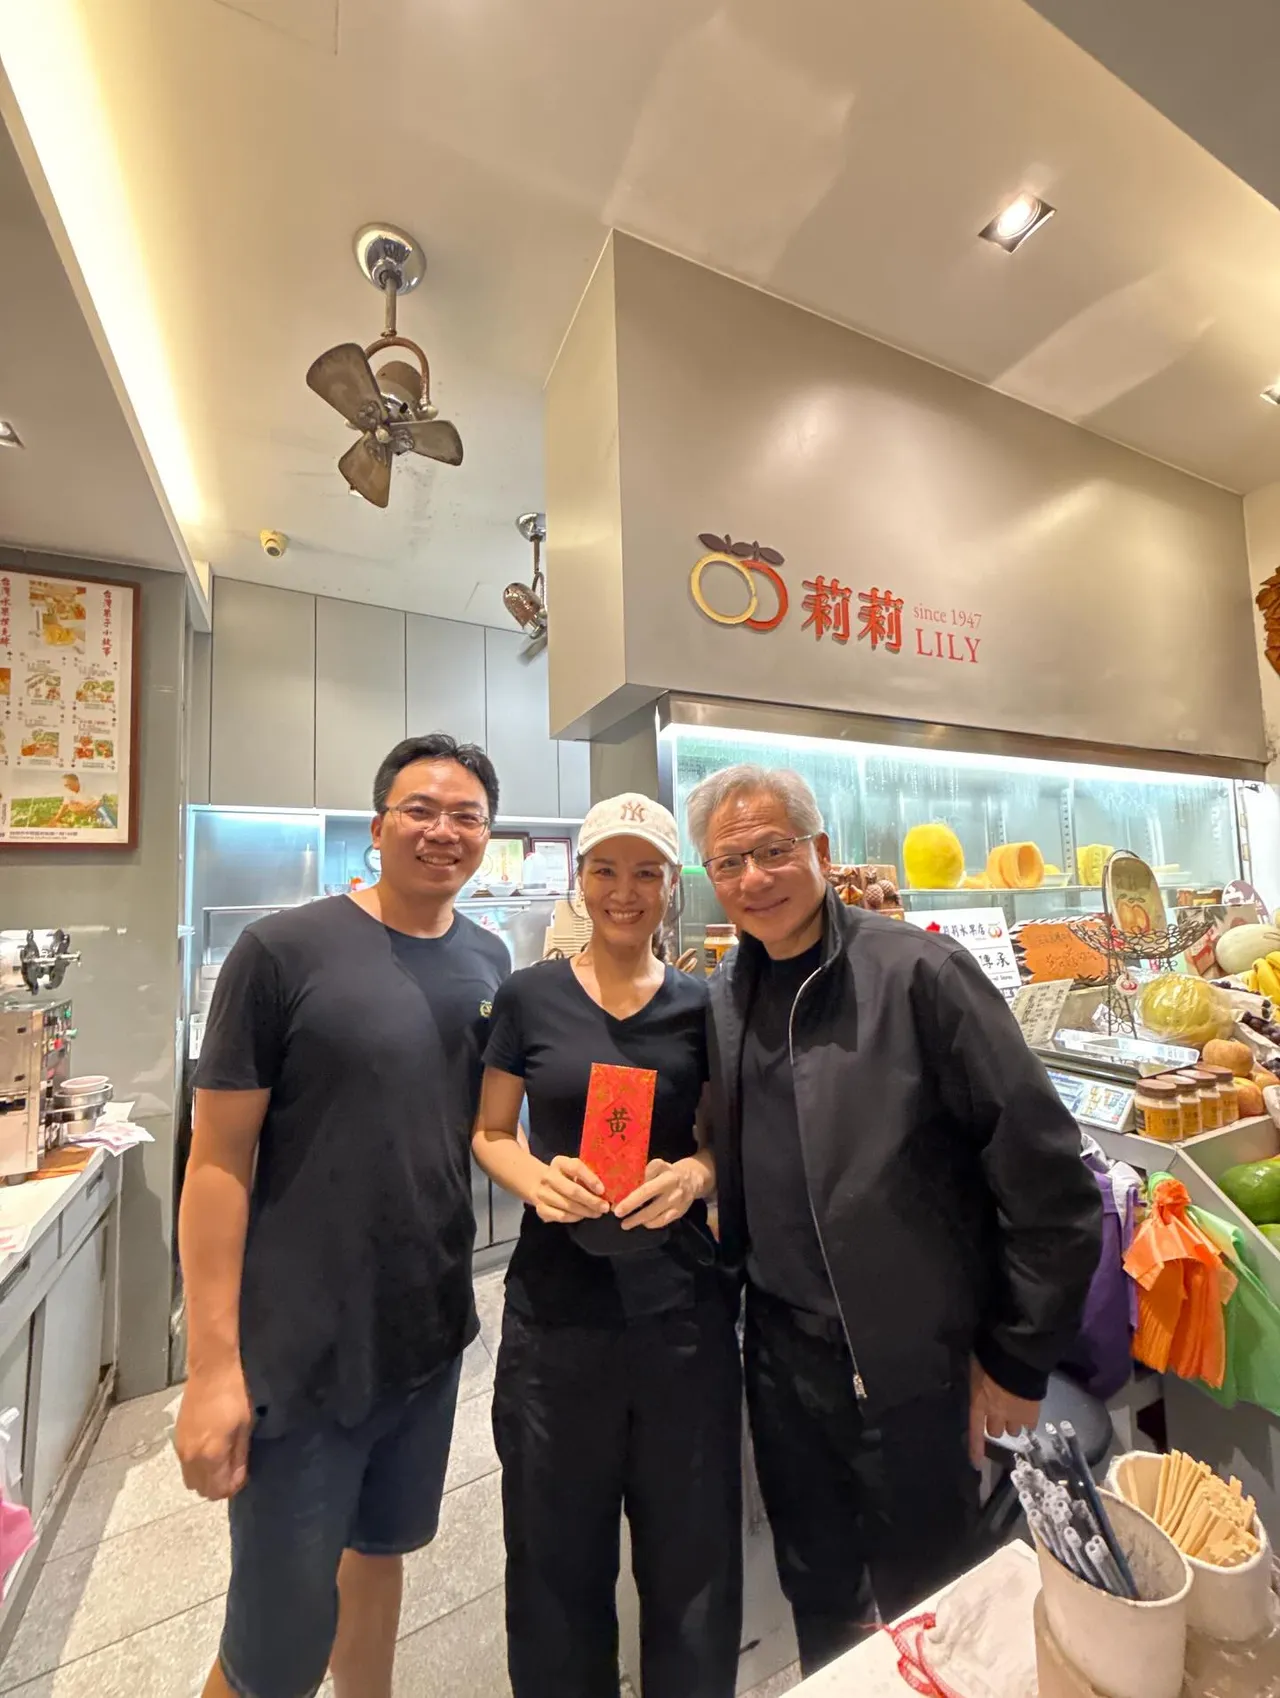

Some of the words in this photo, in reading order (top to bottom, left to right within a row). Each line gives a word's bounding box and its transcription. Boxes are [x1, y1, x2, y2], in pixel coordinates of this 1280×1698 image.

[801, 575, 904, 654] 莉莉
[913, 603, 947, 624] since
[951, 609, 982, 629] 1947
[915, 628, 982, 663] LILY
[620, 800, 646, 823] NY
